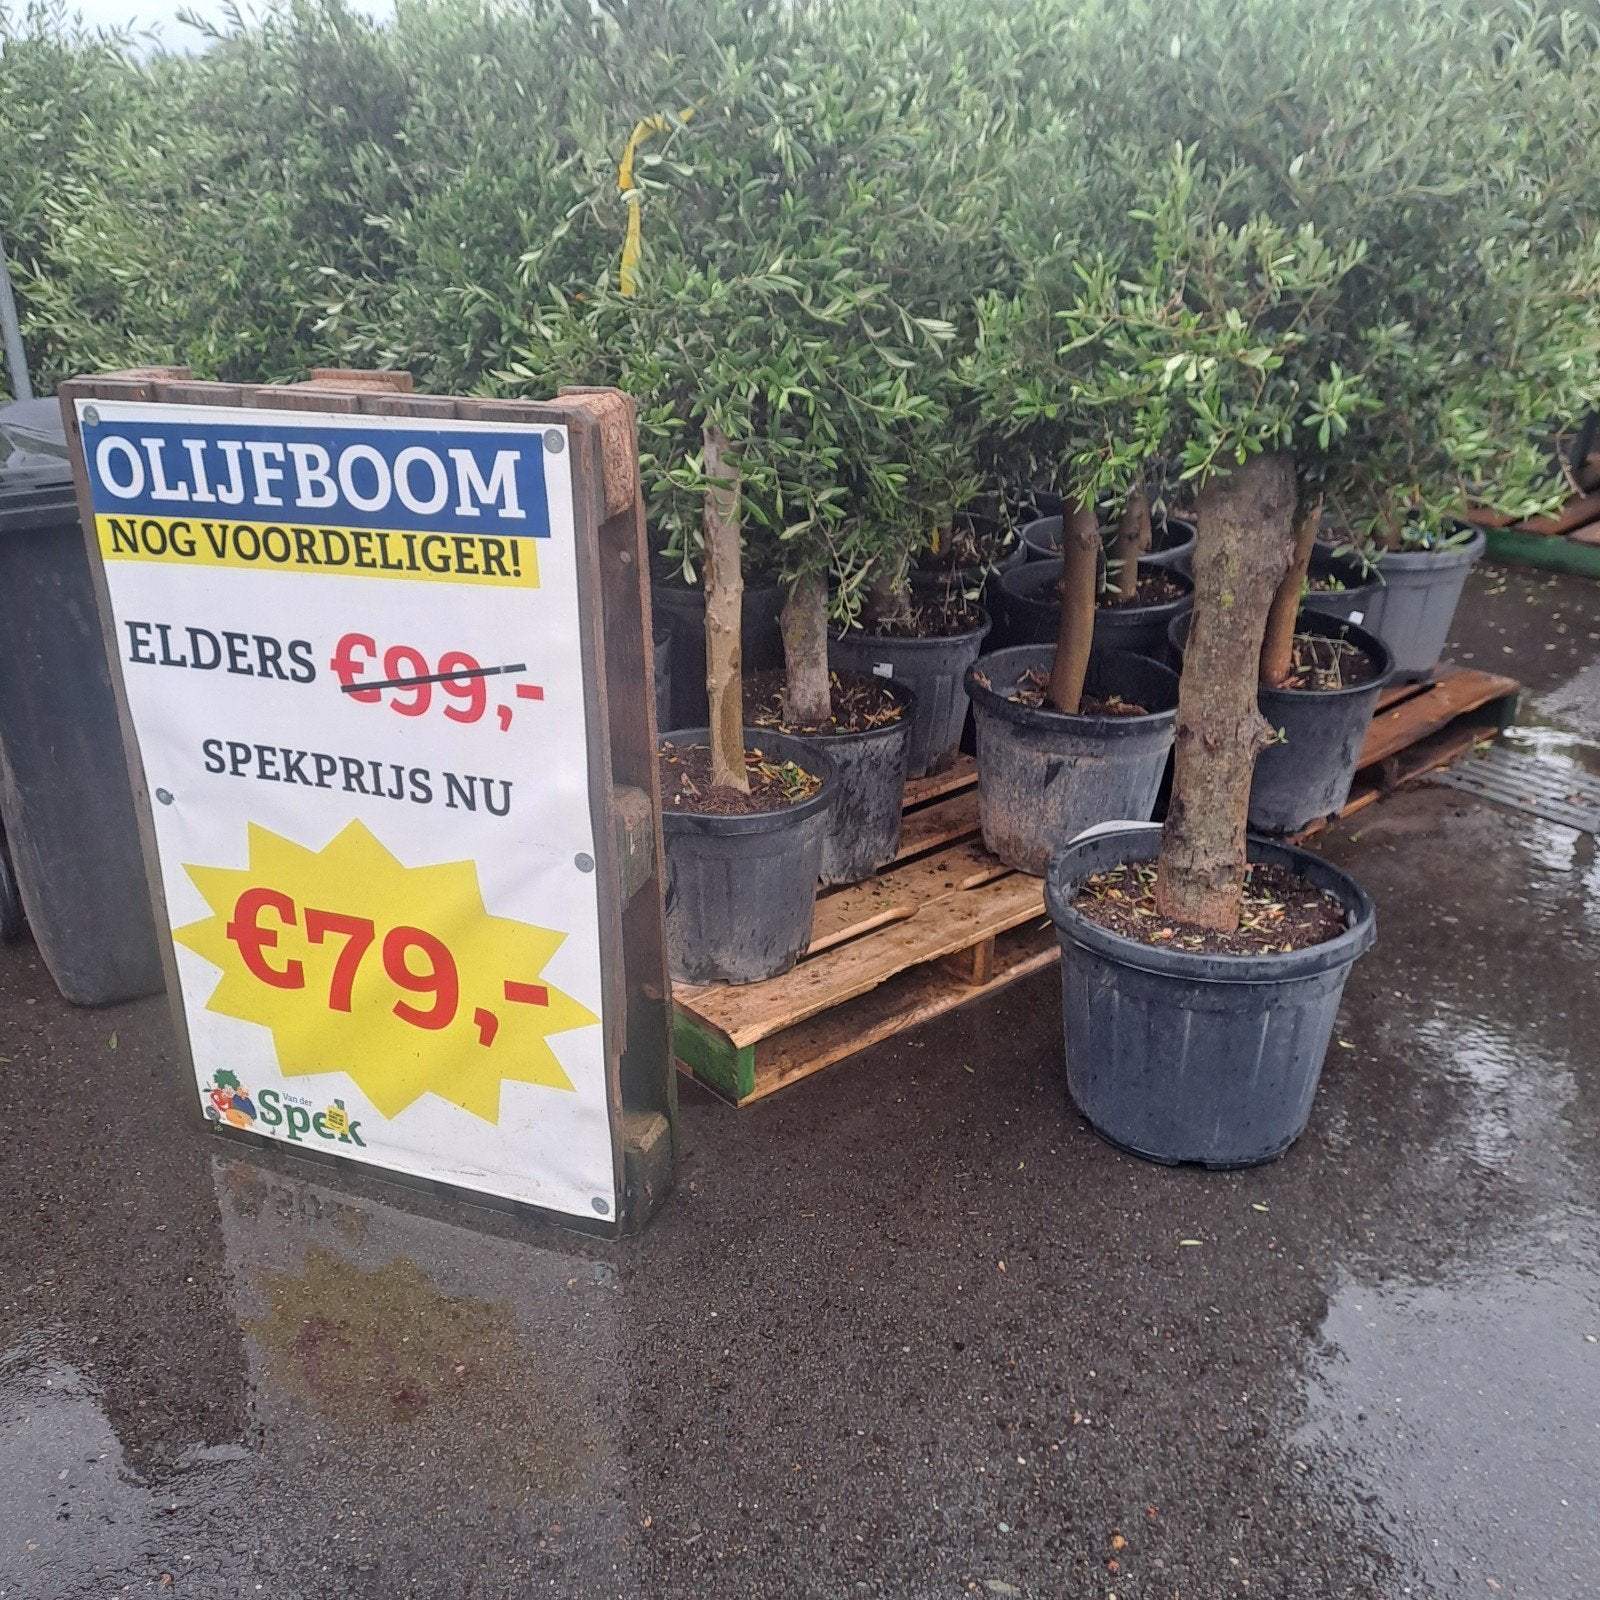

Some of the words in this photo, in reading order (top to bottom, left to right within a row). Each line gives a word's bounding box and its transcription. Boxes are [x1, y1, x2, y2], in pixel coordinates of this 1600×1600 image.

[95, 434, 526, 520] OLIJFBOOM
[107, 518, 197, 557] NOG
[201, 523, 522, 578] VOORDELIGER!
[124, 620, 317, 684] ELDERS
[330, 632, 544, 732] €99,-
[202, 738, 434, 804] SPEKPRIJS
[441, 772, 514, 817] NU
[226, 887, 549, 1049] €79,-
[257, 1088, 367, 1148] Spek
[282, 1092, 298, 1104] Van
[299, 1096, 313, 1107] der
